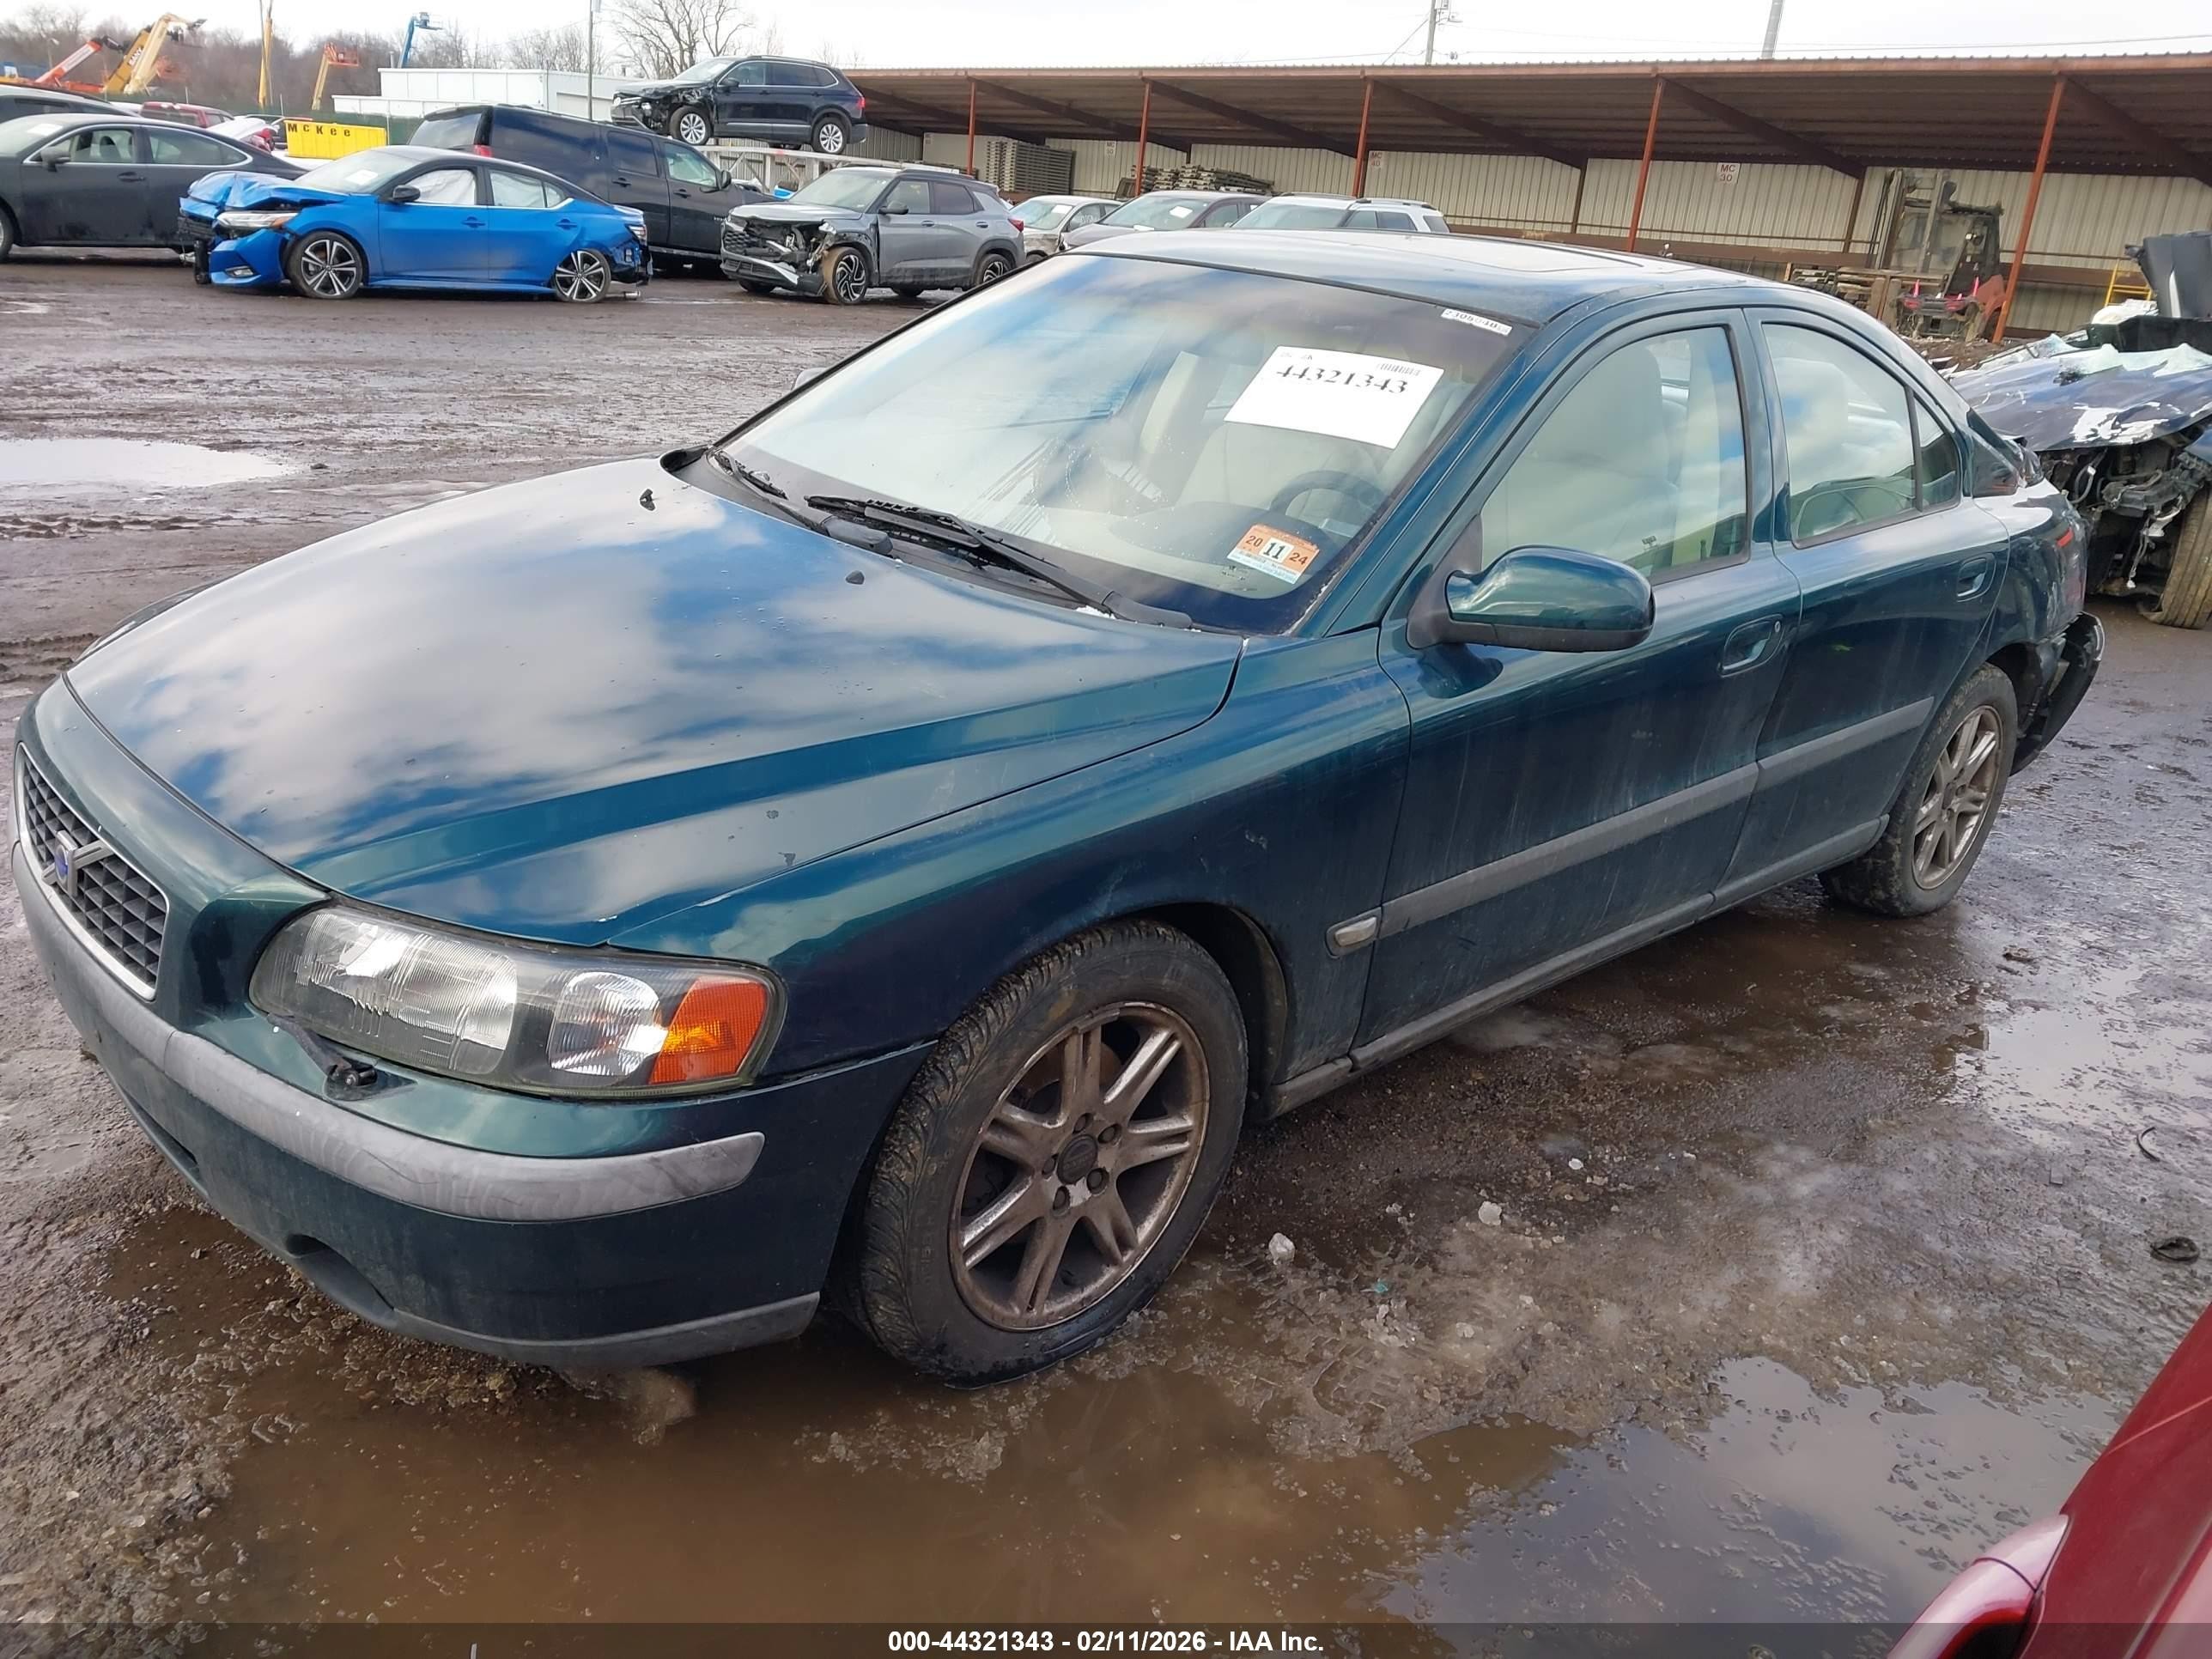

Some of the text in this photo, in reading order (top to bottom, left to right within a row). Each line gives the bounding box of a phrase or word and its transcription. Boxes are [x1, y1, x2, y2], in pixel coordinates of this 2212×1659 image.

[1277, 364, 1408, 393] 44321343
[1246, 535, 1264, 548] 20
[1263, 542, 1285, 560] 11
[1289, 552, 1309, 565] 24
